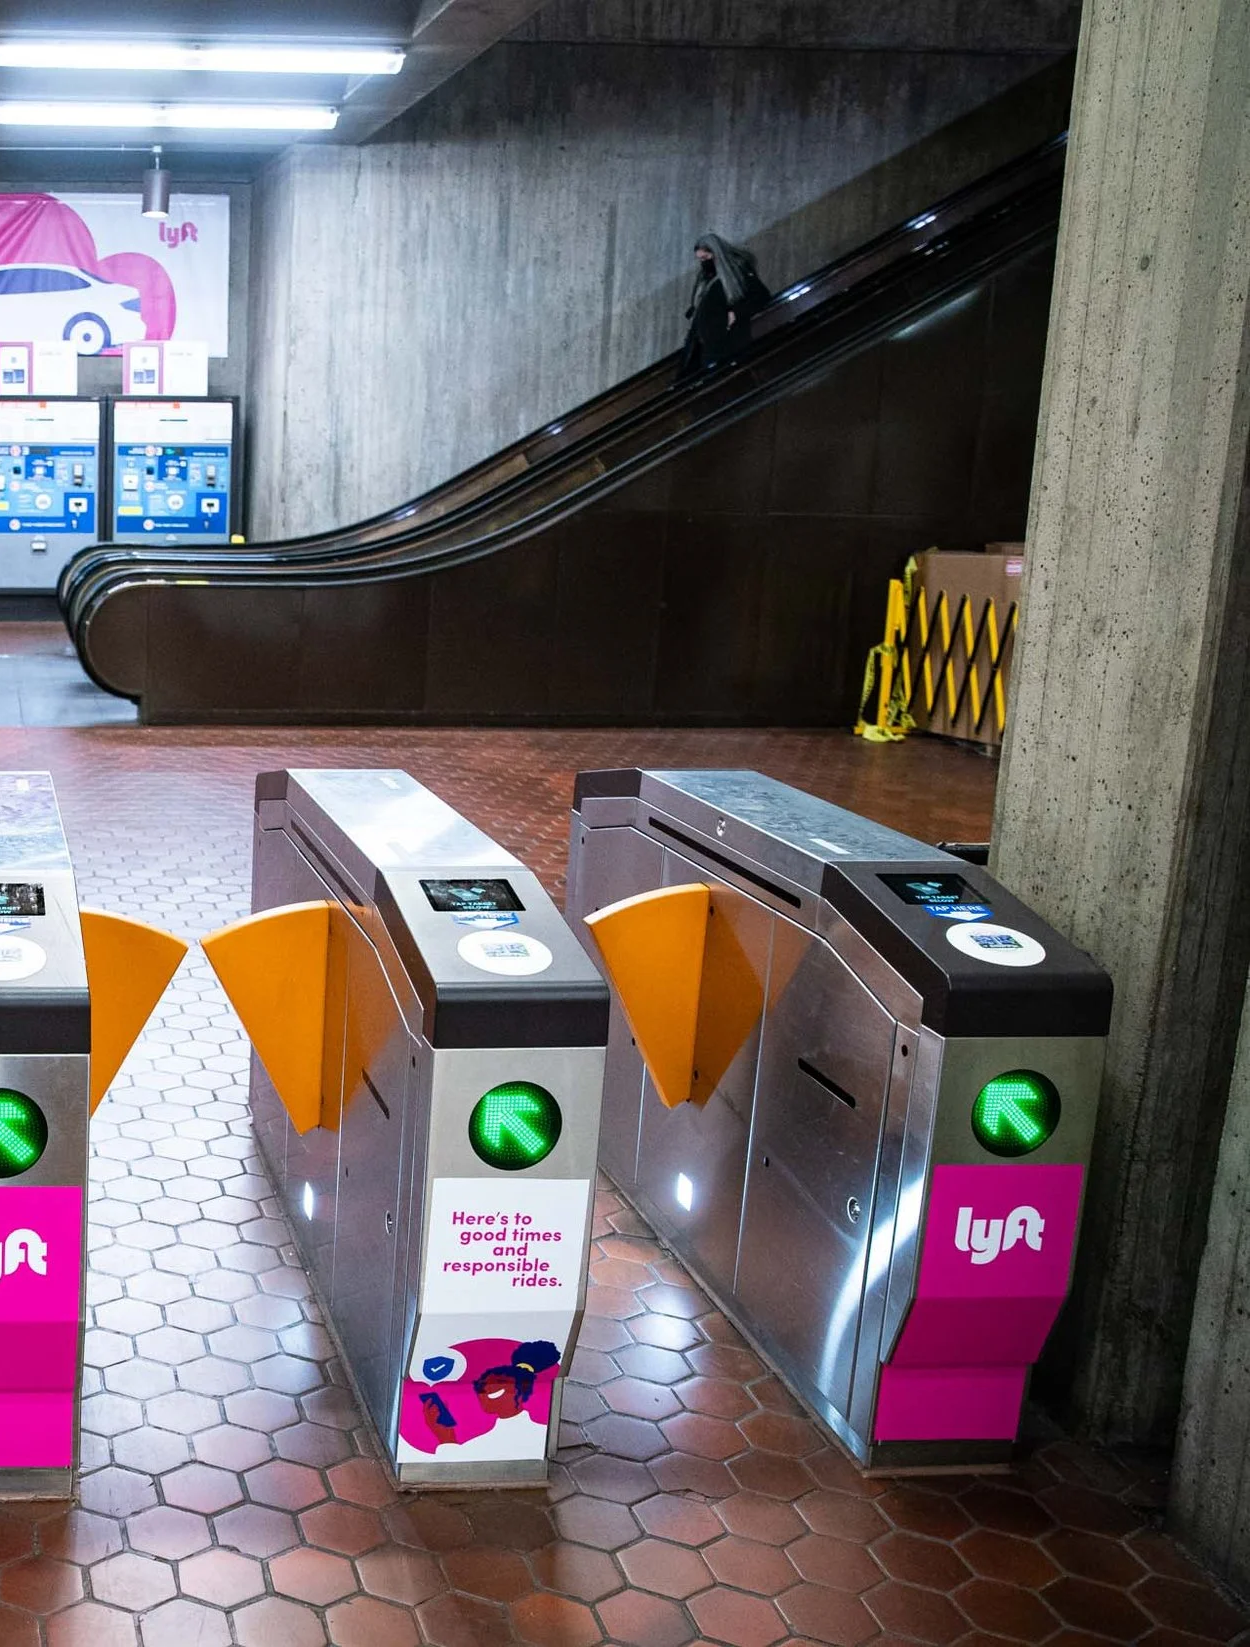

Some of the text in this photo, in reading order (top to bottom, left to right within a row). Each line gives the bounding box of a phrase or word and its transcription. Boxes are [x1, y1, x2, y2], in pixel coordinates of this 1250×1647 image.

[159, 221, 198, 249] lyft
[452, 1211, 532, 1226] Here's to
[460, 1228, 562, 1245] good times
[954, 1205, 1045, 1265] lyft
[493, 1243, 528, 1256] and
[443, 1258, 550, 1276] responsible
[512, 1274, 563, 1287] rides.
